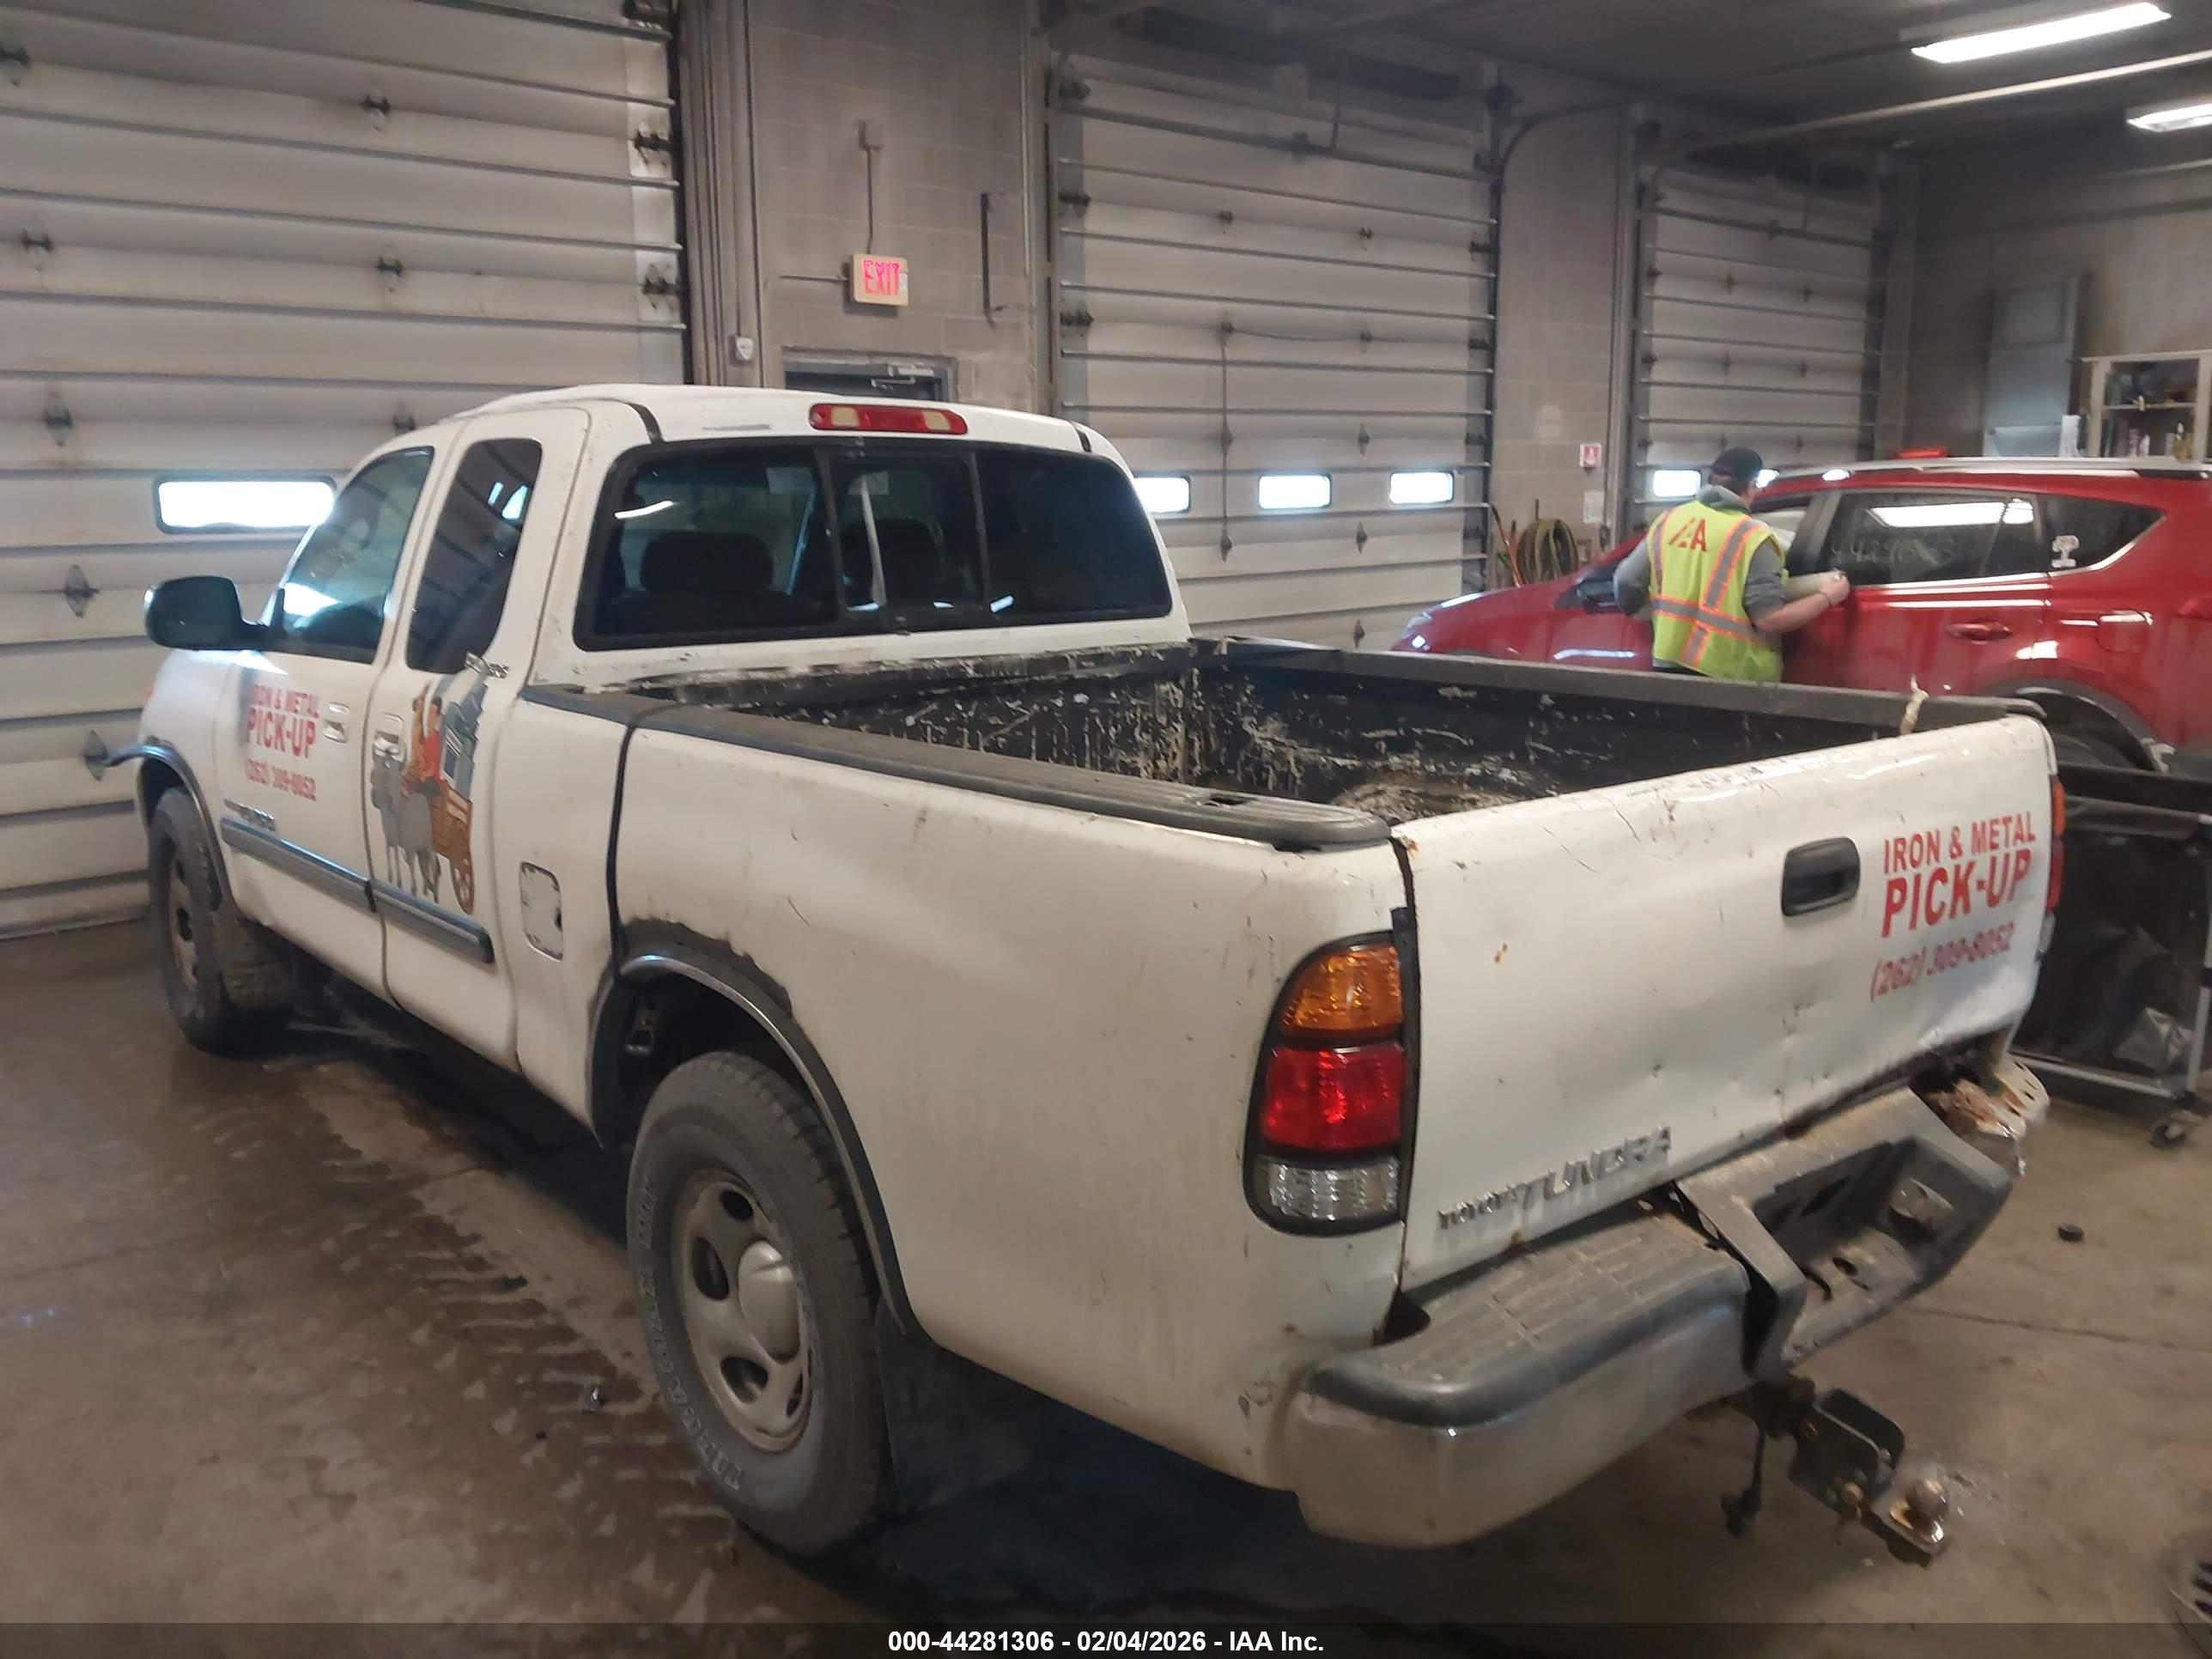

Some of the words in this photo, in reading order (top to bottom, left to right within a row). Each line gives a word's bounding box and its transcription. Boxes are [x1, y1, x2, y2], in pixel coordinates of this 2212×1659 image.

[863, 260, 900, 295] EXIT
[246, 706, 317, 759] PICK-UP
[286, 690, 319, 720] METAL
[1883, 829, 1942, 875] IRON
[1948, 825, 1963, 860] &
[1971, 811, 2036, 855] METAL
[1881, 848, 2033, 939] PICK-UP
[1511, 1126, 1672, 1212] TUNDRA
